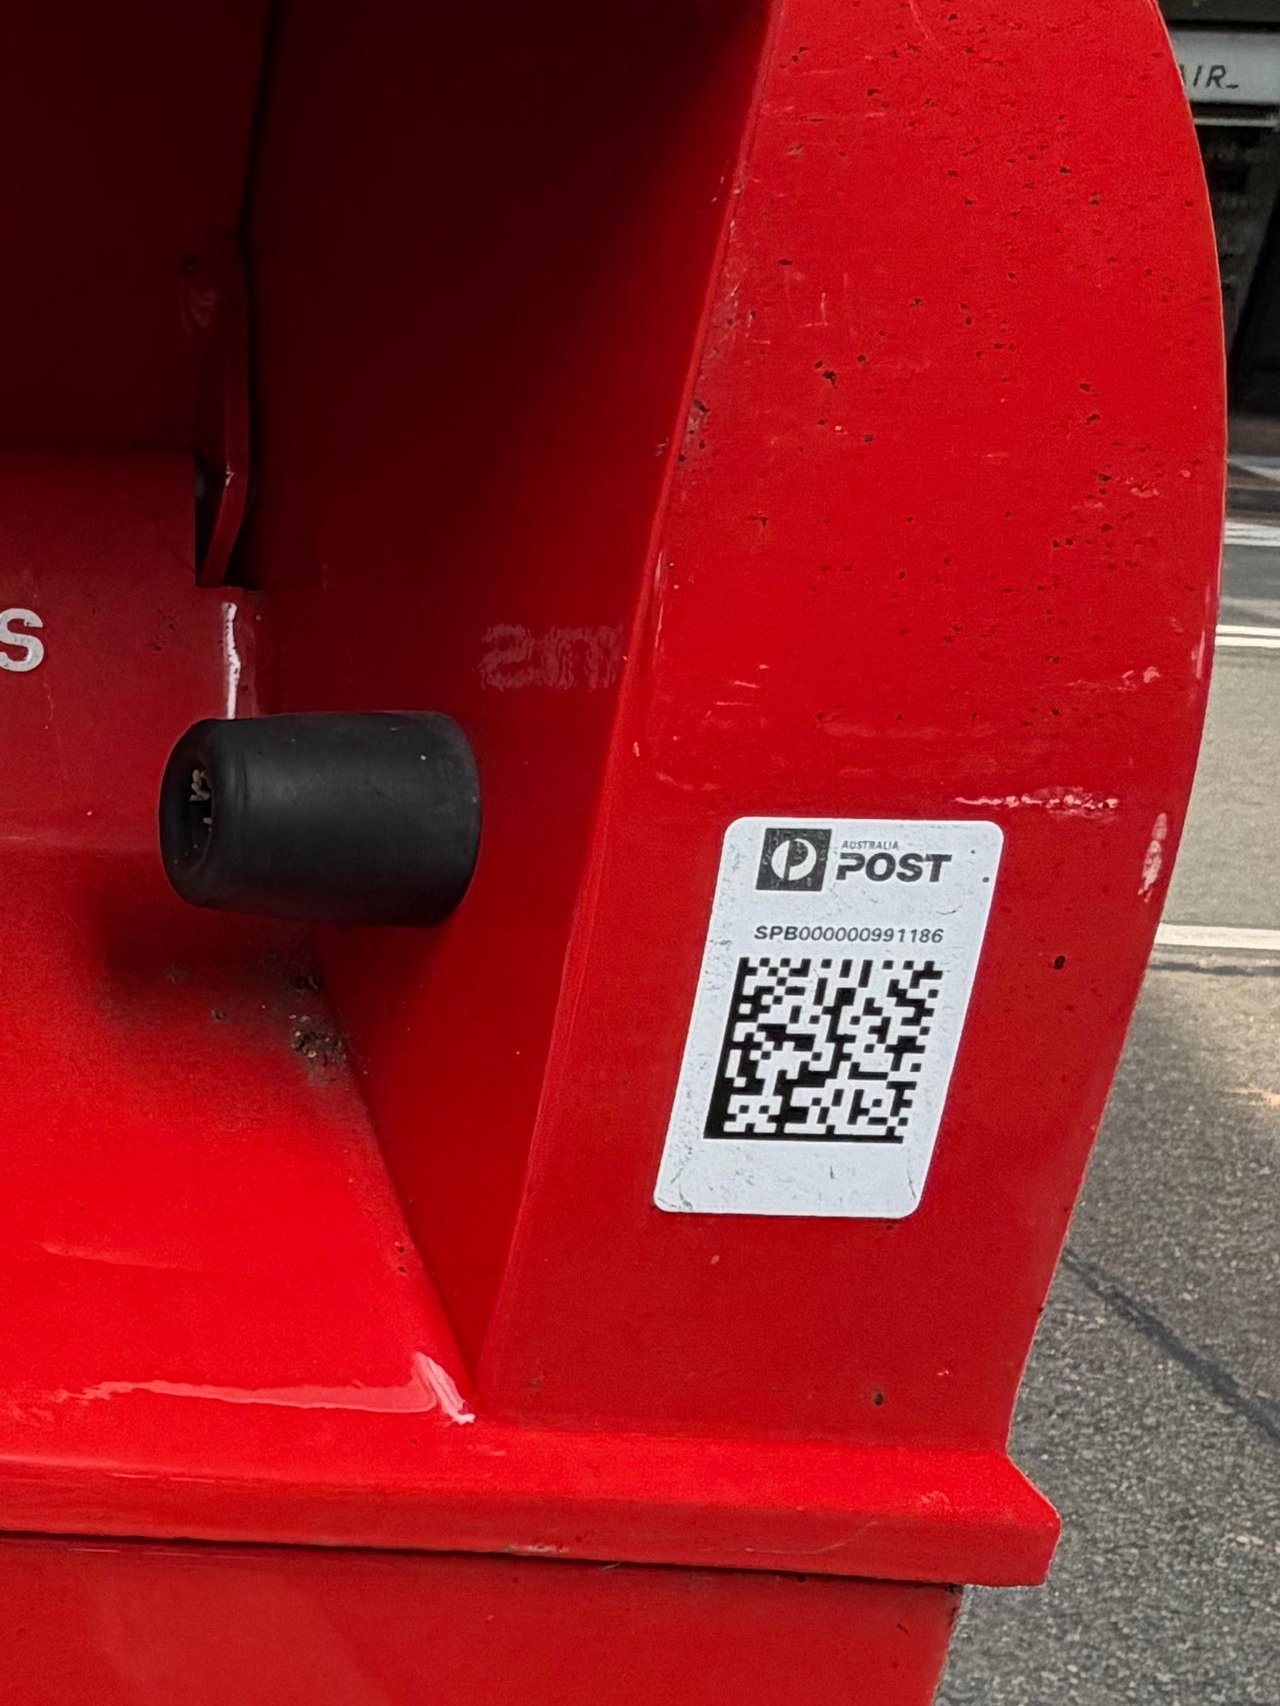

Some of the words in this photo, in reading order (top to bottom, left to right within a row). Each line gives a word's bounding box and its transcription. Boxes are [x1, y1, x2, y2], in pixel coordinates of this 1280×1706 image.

[842, 840, 899, 850] AUSTRALIA
[836, 853, 953, 883] POST
[754, 926, 944, 944] SPB000000991186
